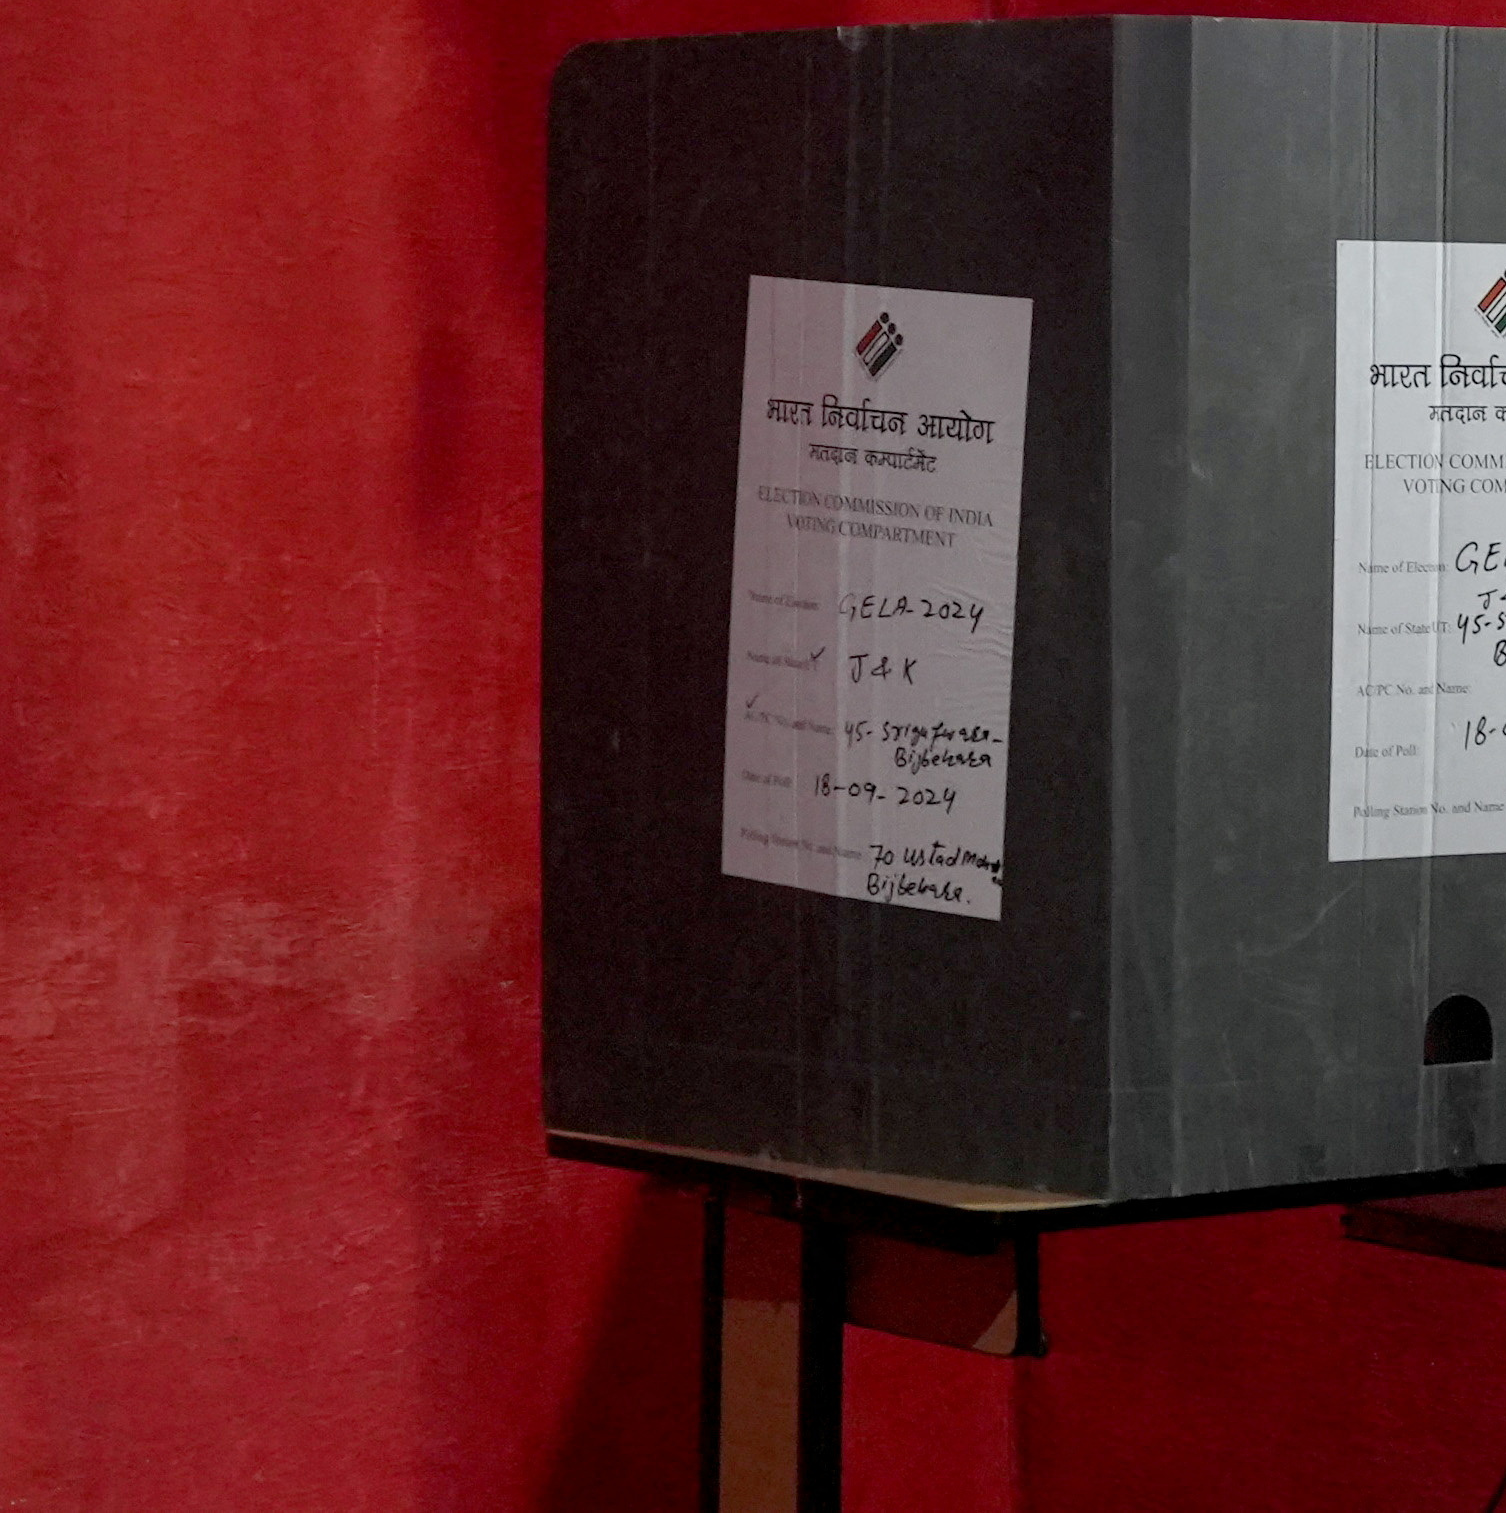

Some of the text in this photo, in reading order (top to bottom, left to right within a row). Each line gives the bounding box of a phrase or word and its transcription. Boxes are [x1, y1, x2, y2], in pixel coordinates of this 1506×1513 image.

[1370, 363, 1432, 389] भारत
[767, 394, 995, 444] भारत निर्वाचन आयोग
[1428, 405, 1488, 424] मतदान
[1364, 453, 1443, 470] ELECTION
[1403, 478, 1465, 494] VOTING
[758, 486, 994, 528] ELECTION COMMISSION OF INDIA
[838, 520, 957, 548] COMPARTMENT
